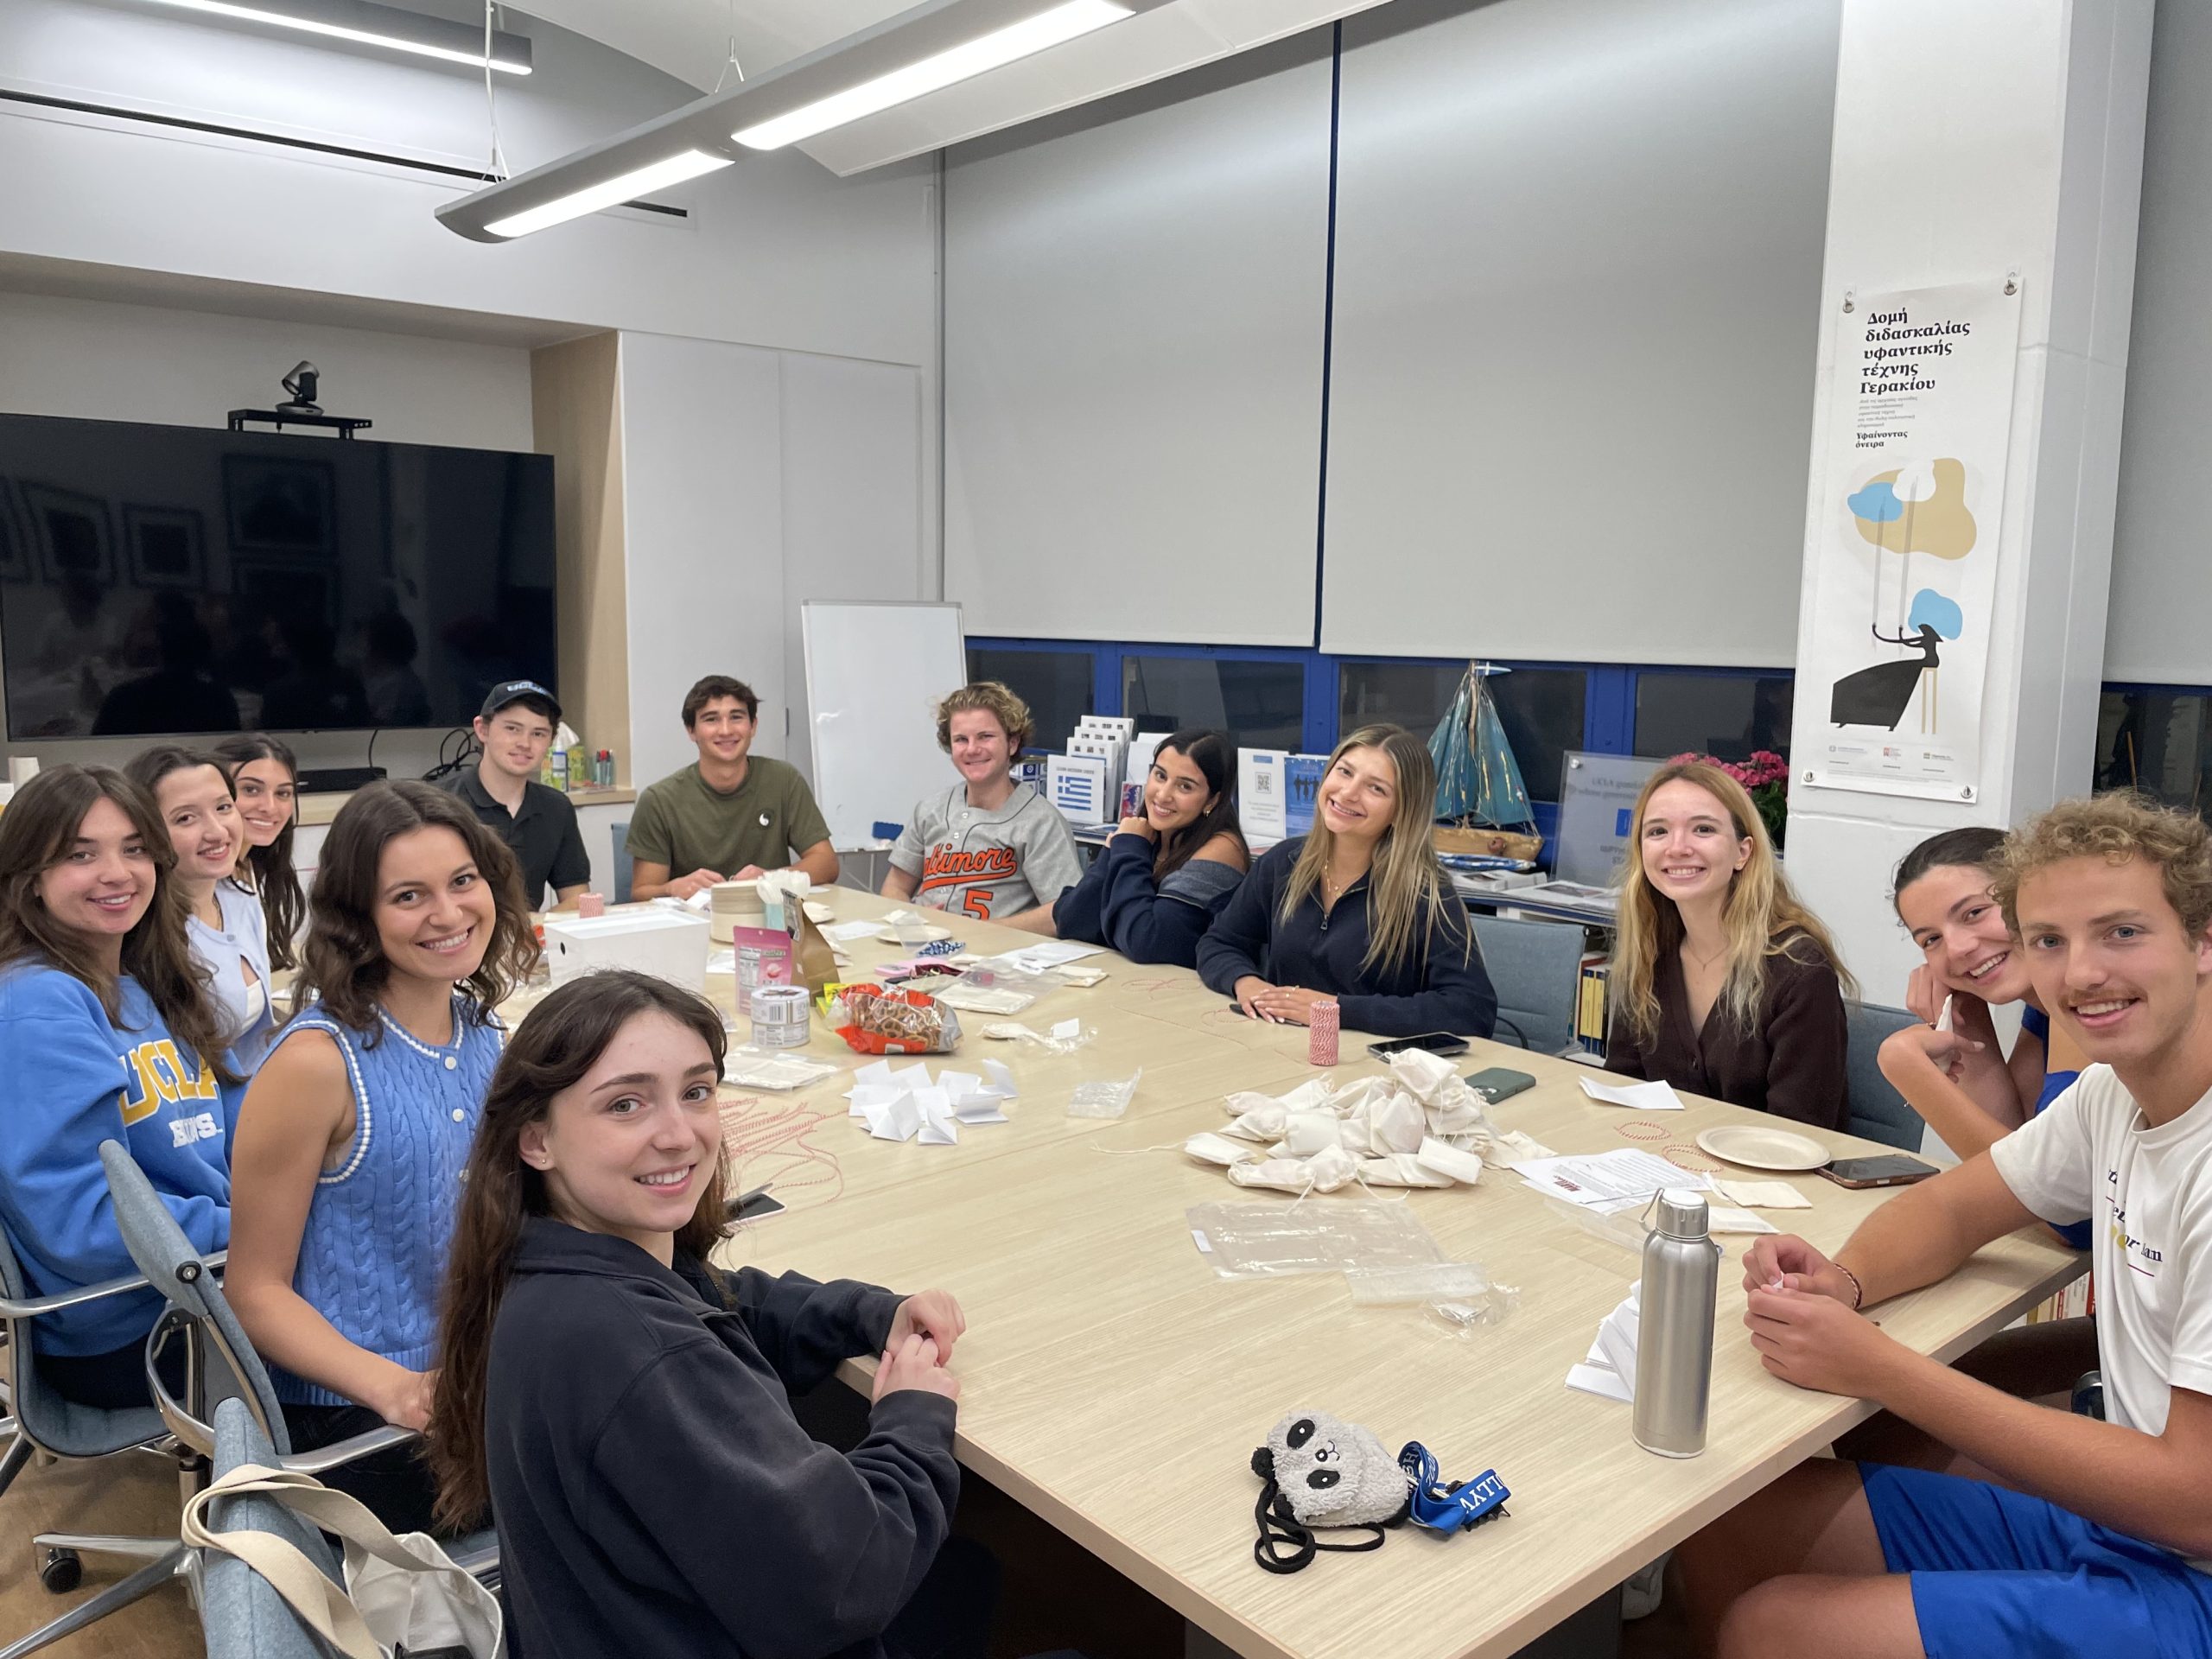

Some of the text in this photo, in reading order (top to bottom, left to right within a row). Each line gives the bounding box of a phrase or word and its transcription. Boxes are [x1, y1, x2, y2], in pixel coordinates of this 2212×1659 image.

[1866, 308, 1908, 326] Δομή
[1865, 320, 1971, 342] διδασκαλίας
[1863, 339, 1953, 361] υφαντικής
[1861, 362, 1919, 378] τέχνης
[1859, 377, 1936, 395] Γερακίου
[1855, 440, 1885, 448] όνειρα
[1856, 430, 1909, 441] Υφαίνοντας
[963, 888, 994, 919] 5
